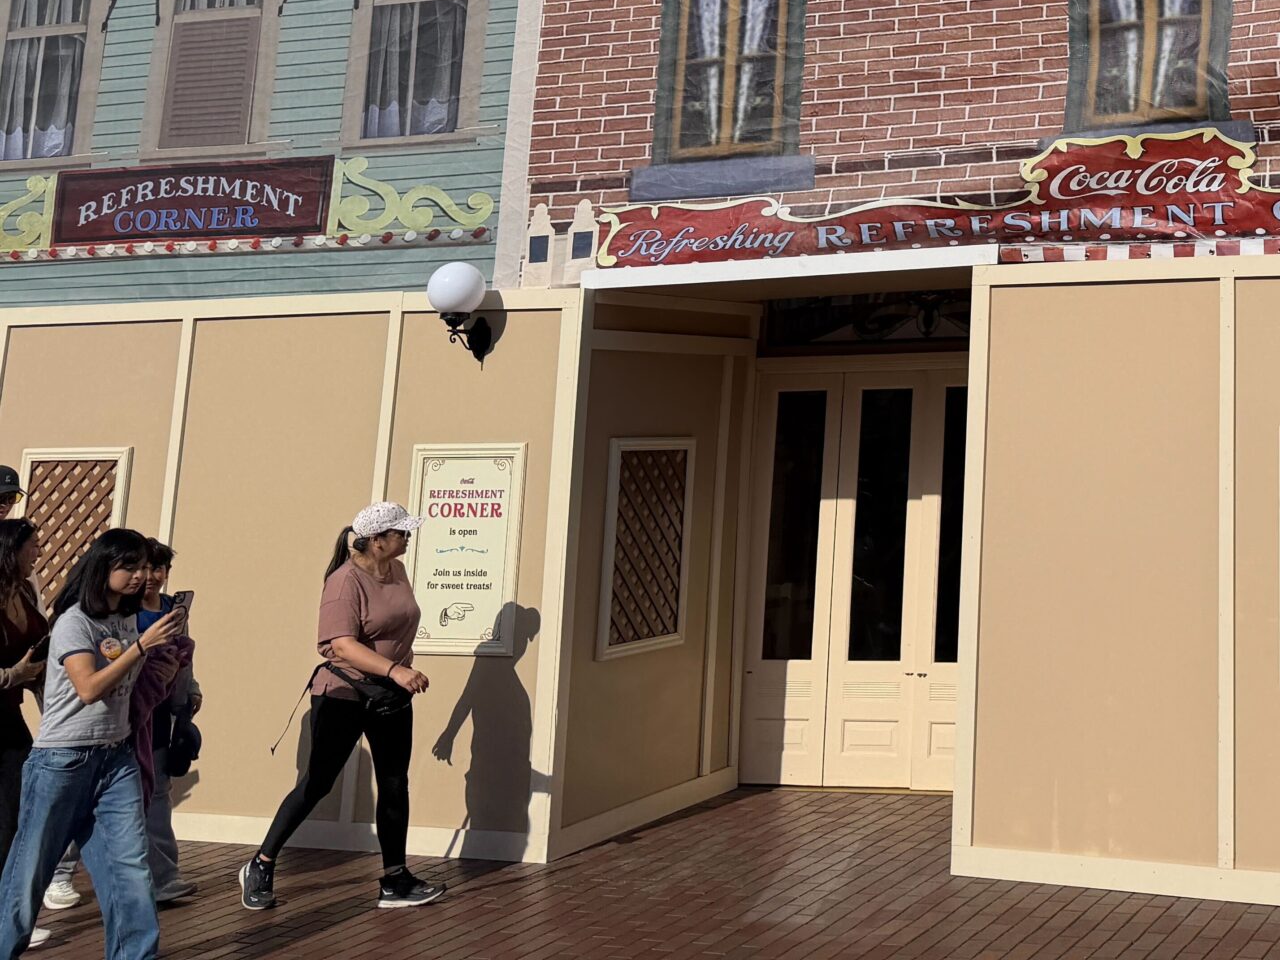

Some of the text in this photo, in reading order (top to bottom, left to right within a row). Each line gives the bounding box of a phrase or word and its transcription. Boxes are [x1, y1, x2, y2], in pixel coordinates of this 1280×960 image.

[1049, 156, 1226, 200] Coca-Cola
[77, 175, 303, 227] REFRESHMENT
[113, 205, 259, 234] CORNER
[617, 222, 795, 262] Refreshing
[817, 202, 1234, 249] REFRESHMENT
[429, 490, 504, 499] REFRESHMENT
[428, 502, 503, 518] CORNER
[449, 528, 477, 538] is open
[433, 569, 450, 577] Join
[463, 569, 488, 577] inside
[427, 581, 492, 590] for sweet treats!
